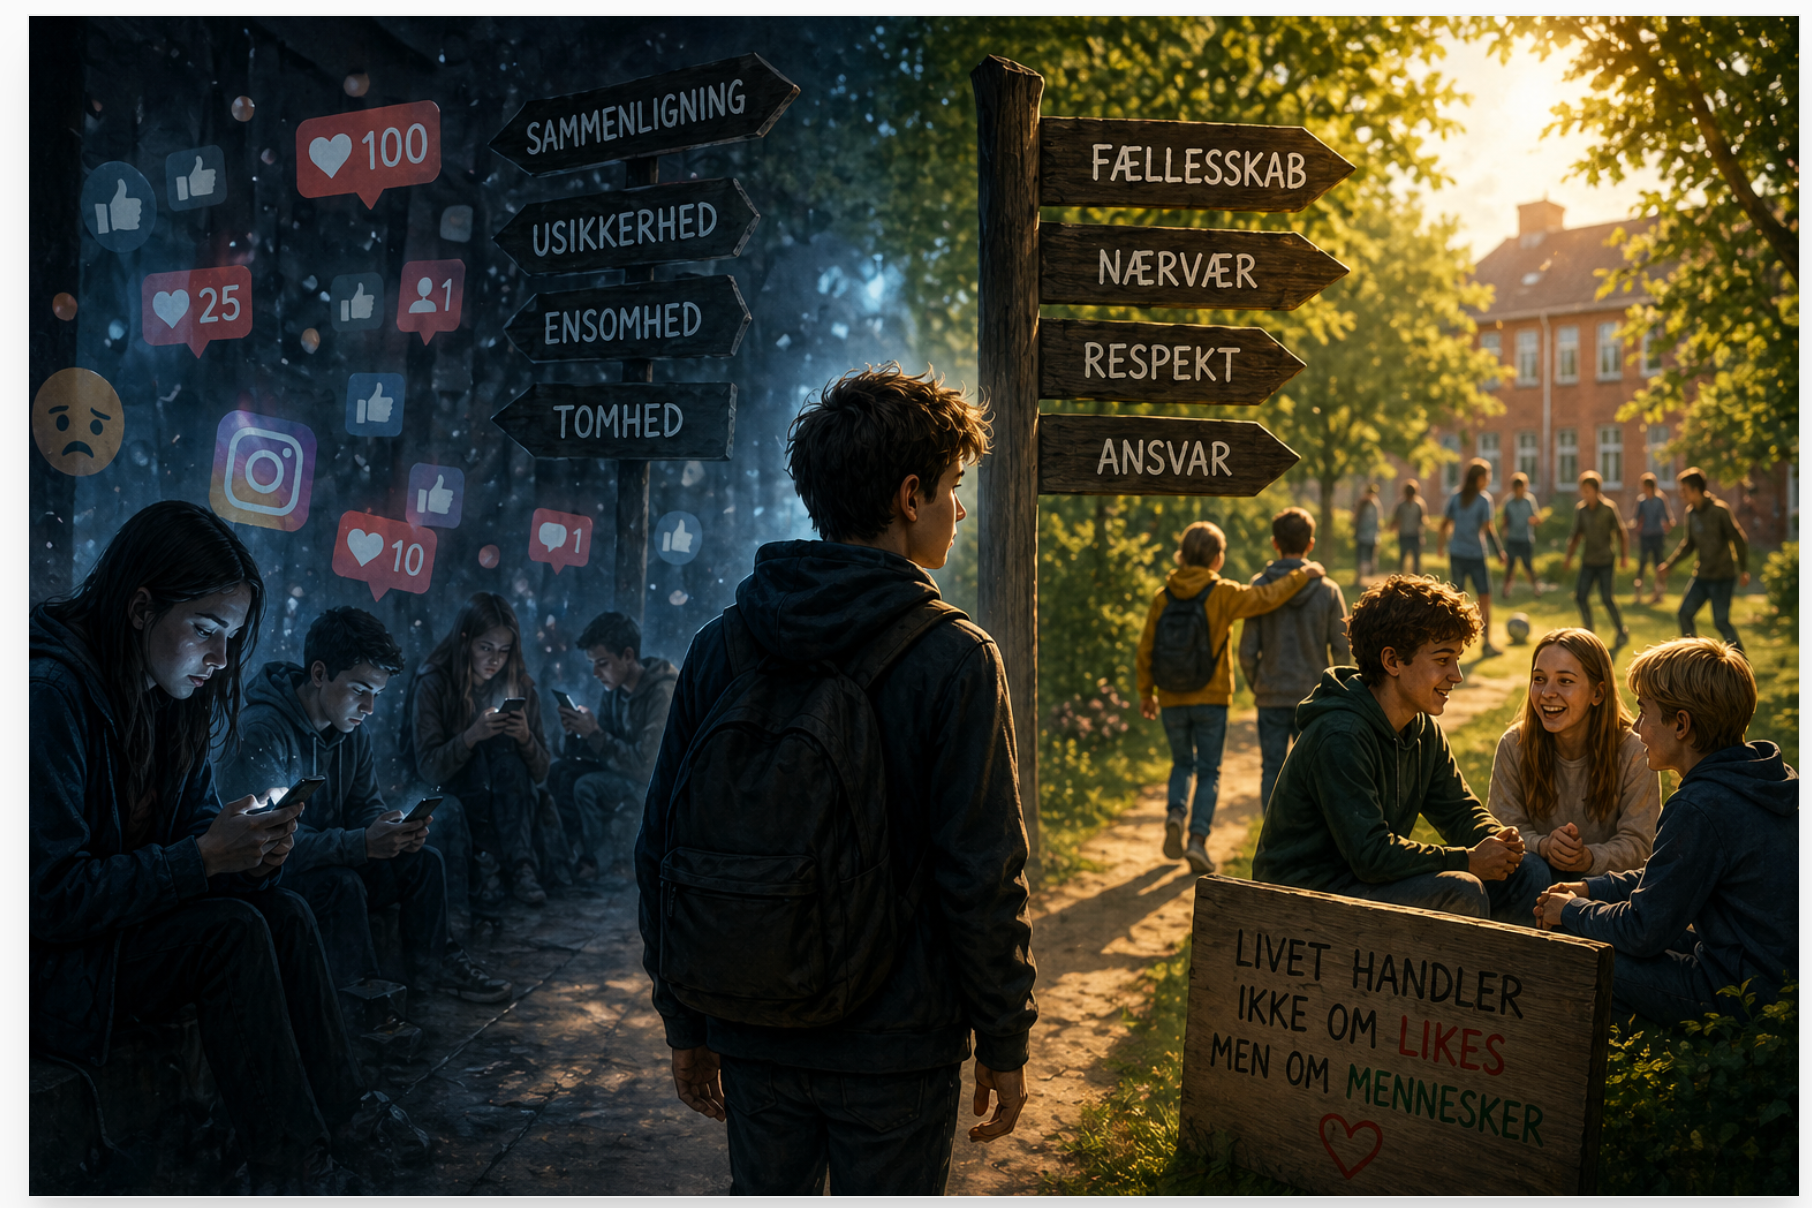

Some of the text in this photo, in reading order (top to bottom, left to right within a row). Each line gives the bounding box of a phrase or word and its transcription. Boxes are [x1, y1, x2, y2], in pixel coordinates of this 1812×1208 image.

[526, 79, 746, 155] SAMMENLIGNING
[361, 122, 428, 170] 100
[1092, 144, 1307, 189] FÆLLESSKAB
[532, 201, 717, 257] USIKKERHED
[1098, 249, 1258, 289] NÆRVÆR
[198, 284, 241, 324] 25
[440, 278, 453, 313] 1
[544, 301, 701, 345] ENSOMHED
[1084, 341, 1241, 383] RESPEKT
[553, 402, 683, 439] TOMHED
[1096, 438, 1233, 476] ANSVAR
[390, 538, 424, 577] 10
[573, 527, 582, 554] 1
[1235, 929, 1524, 1020] LIVET HANDLER
[1238, 984, 1506, 1077] IKKE OM LIKES
[1210, 1032, 1545, 1148] MEN OM MENNESKER
